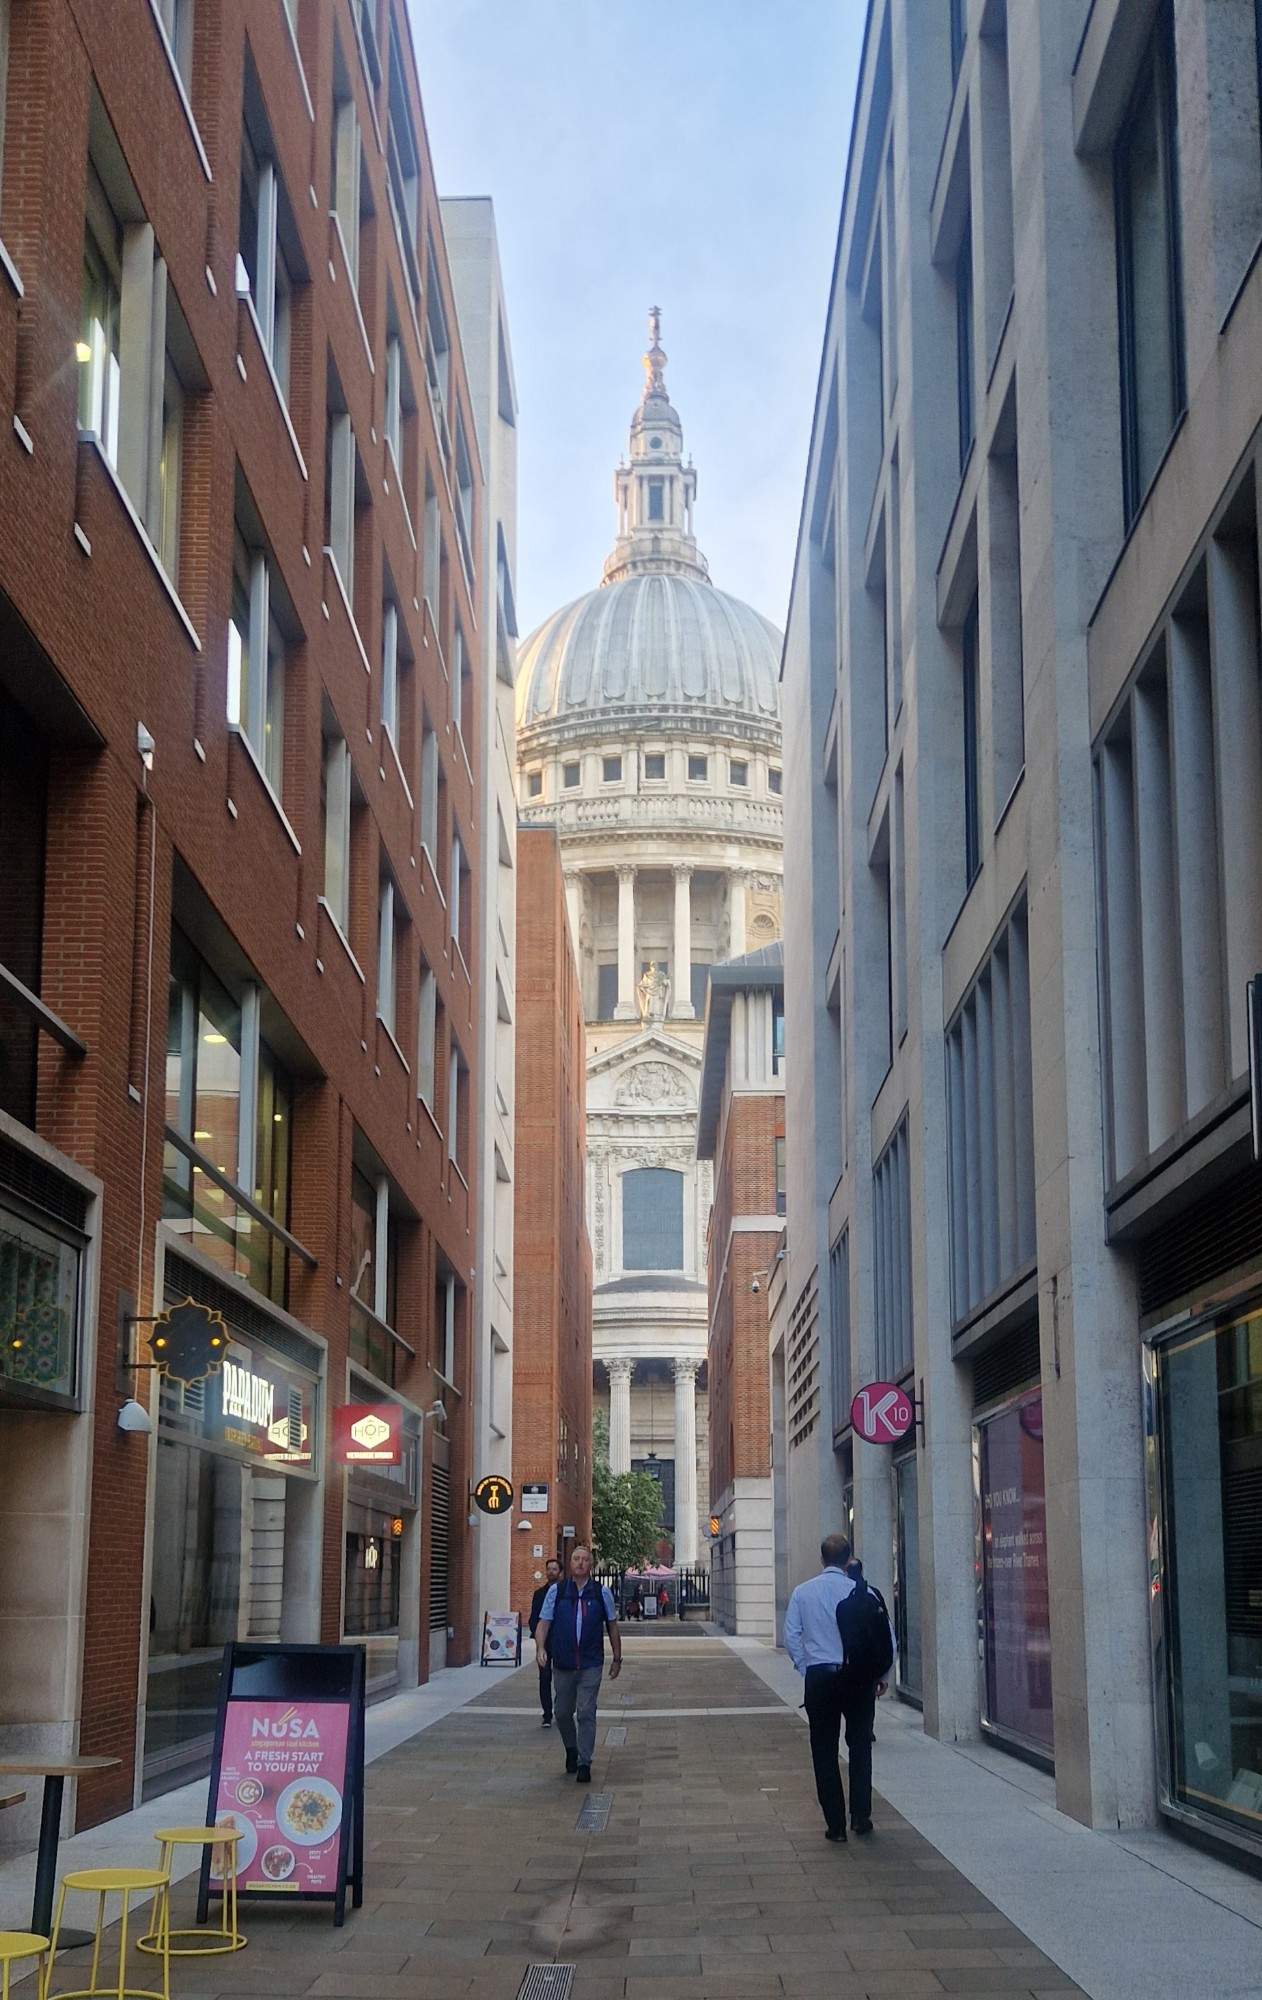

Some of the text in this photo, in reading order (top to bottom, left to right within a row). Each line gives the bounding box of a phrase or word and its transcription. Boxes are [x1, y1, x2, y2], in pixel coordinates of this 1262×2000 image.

[251, 1717, 320, 1738] NUSA
[244, 1751, 324, 1762] A FRESH START
[247, 1762, 262, 1772] TO
[264, 1762, 295, 1773] YOUR
[297, 1763, 320, 1773] DAY
